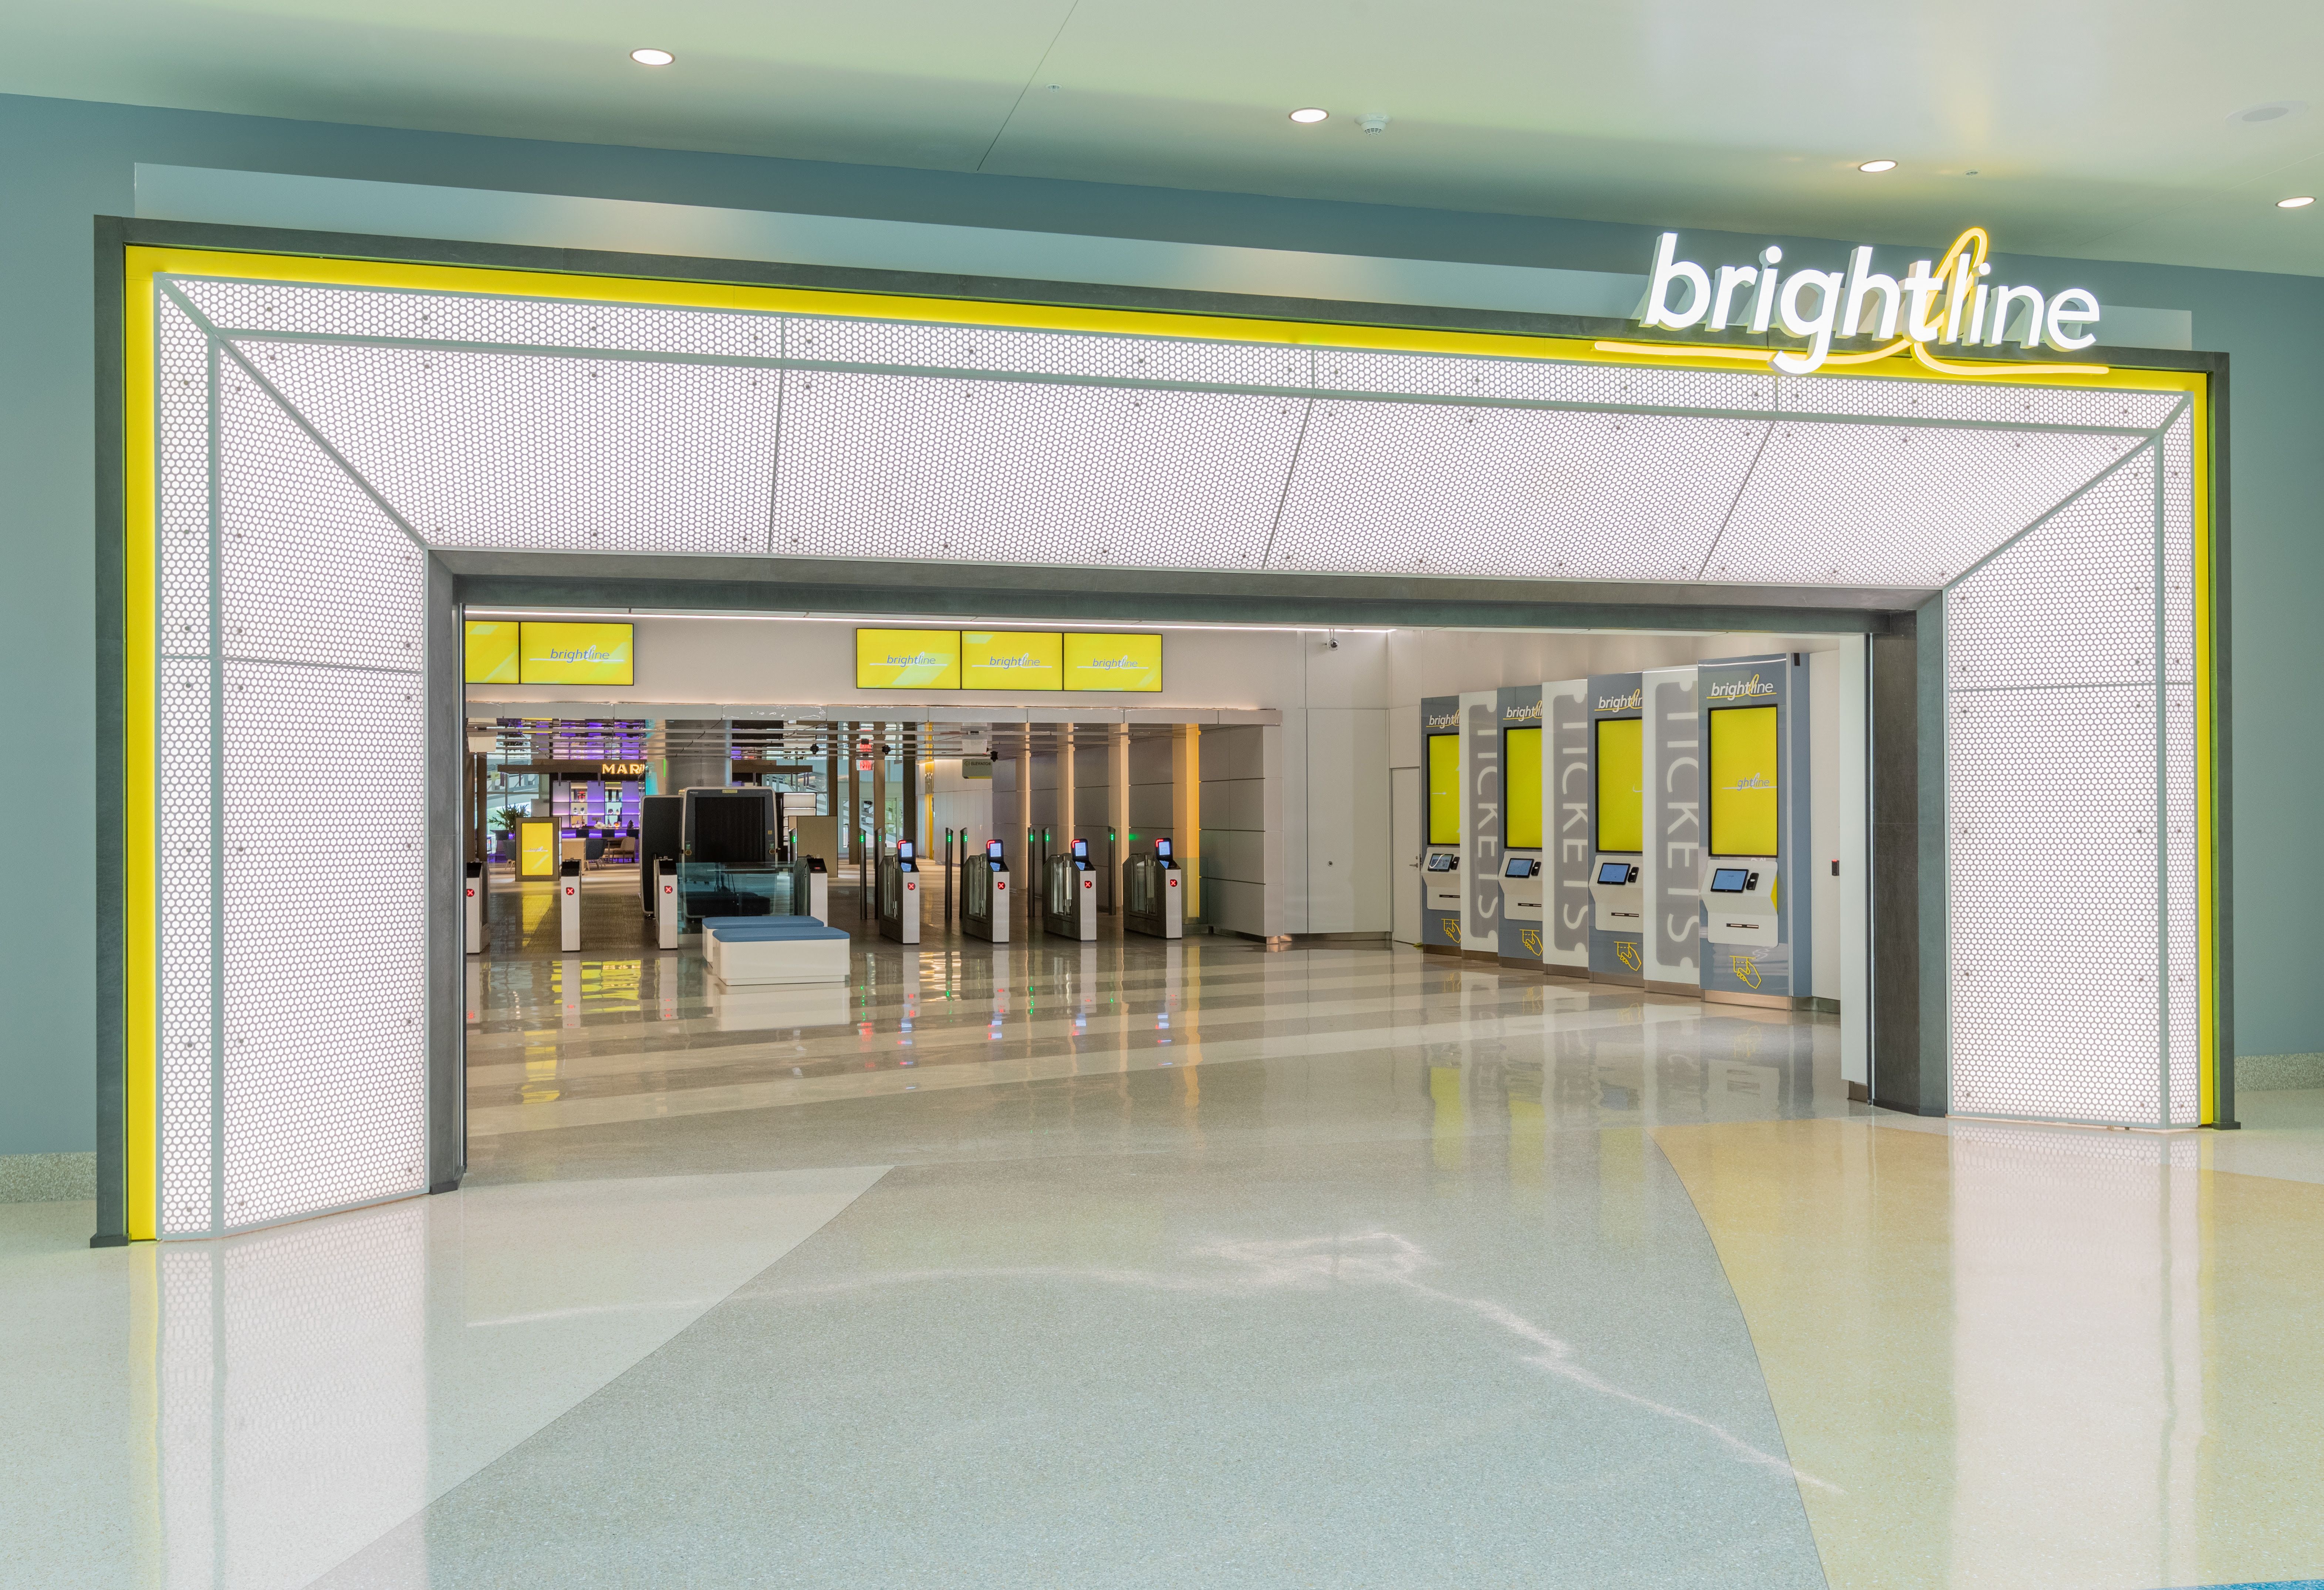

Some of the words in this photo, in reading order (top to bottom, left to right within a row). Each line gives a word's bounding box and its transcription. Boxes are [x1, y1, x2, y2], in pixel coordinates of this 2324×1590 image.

[1639, 227, 2101, 375] brightline
[550, 645, 610, 663] brightline
[887, 652, 936, 667] brightline
[990, 653, 1040, 669] brightline
[1092, 655, 1138, 670] brightline
[1711, 674, 1774, 701] brightline
[1737, 773, 1770, 791] ghtline
